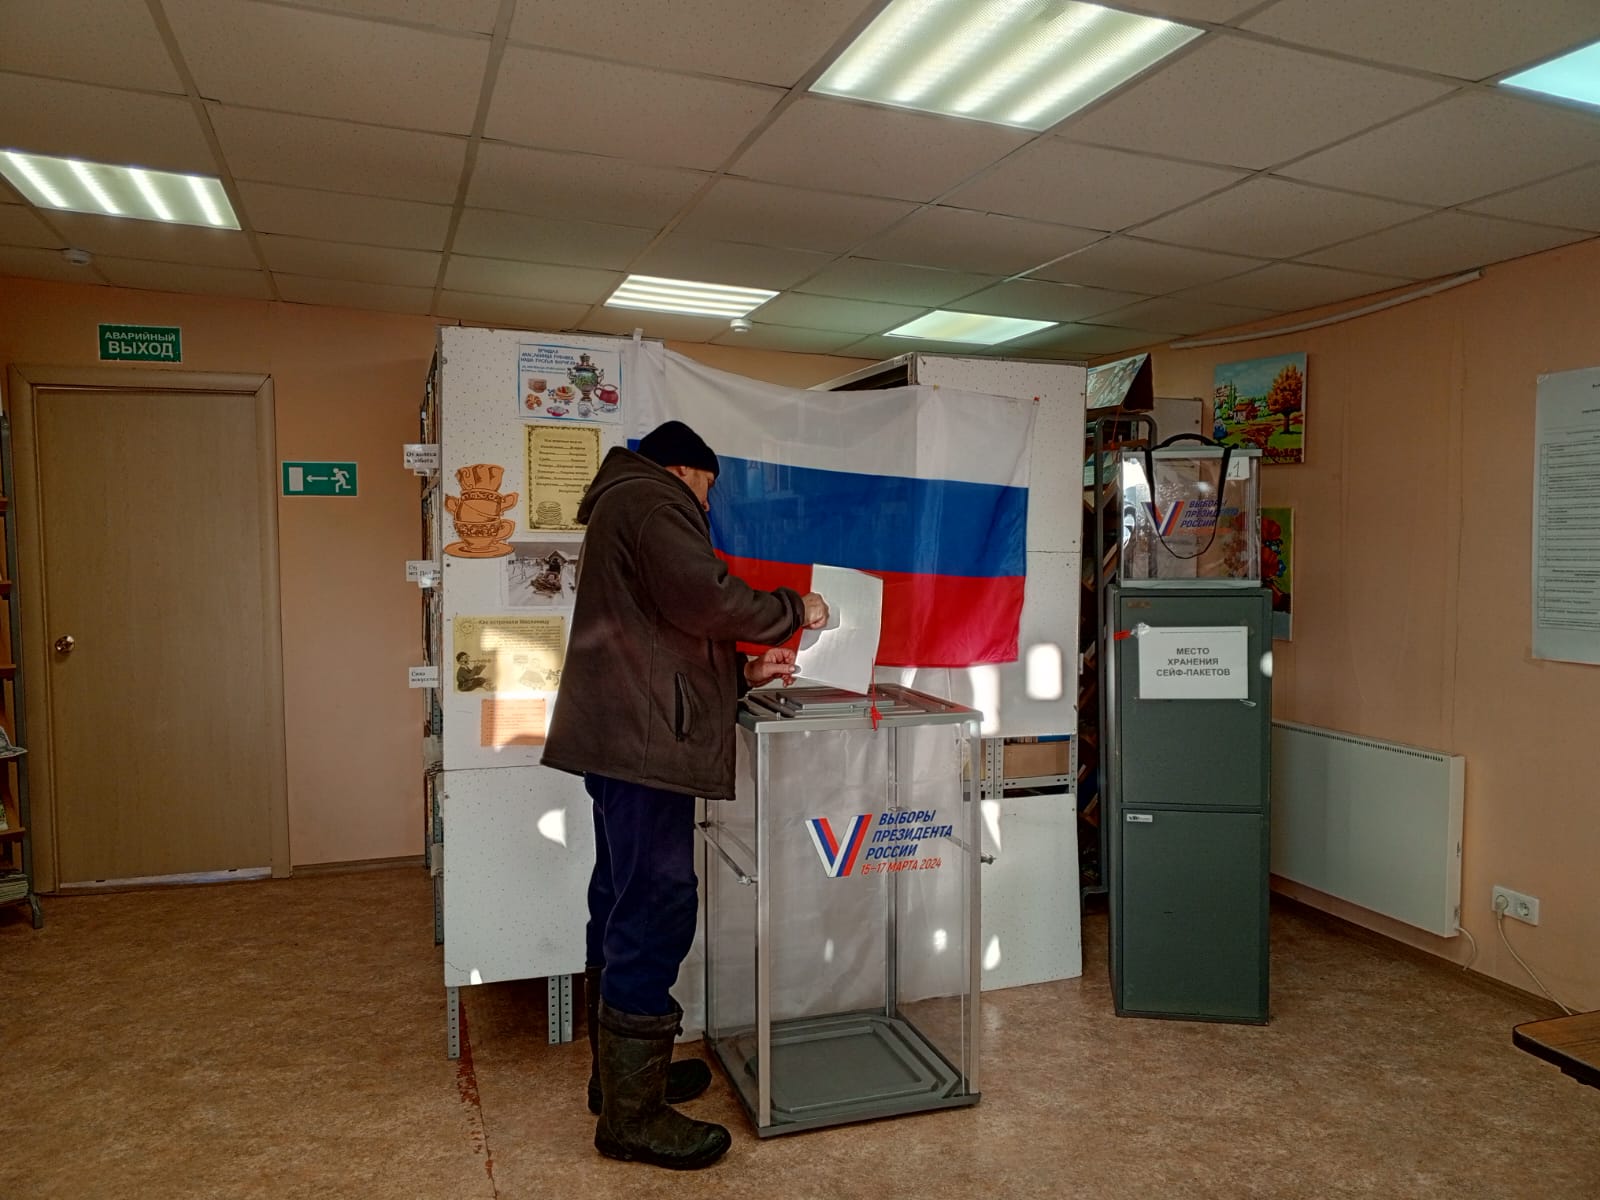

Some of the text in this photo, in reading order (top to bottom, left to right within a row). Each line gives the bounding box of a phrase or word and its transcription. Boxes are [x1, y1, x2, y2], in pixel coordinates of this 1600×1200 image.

[105, 331, 176, 342] АВАРИЙНЫЙ
[108, 341, 174, 358] ВЫХОД
[1176, 647, 1210, 656] МЕСТО
[1167, 658, 1219, 666] ХРАНЕНИЯ
[1156, 667, 1231, 677] СЕЙФ-ПАКЕТОВ
[879, 809, 937, 826] ВЫБОРЫ
[872, 824, 953, 843] ПРЕЗИДЕНТА
[865, 844, 918, 860] РОССИИ
[887, 860, 918, 873] МАРТА
[919, 857, 942, 870] 2024
